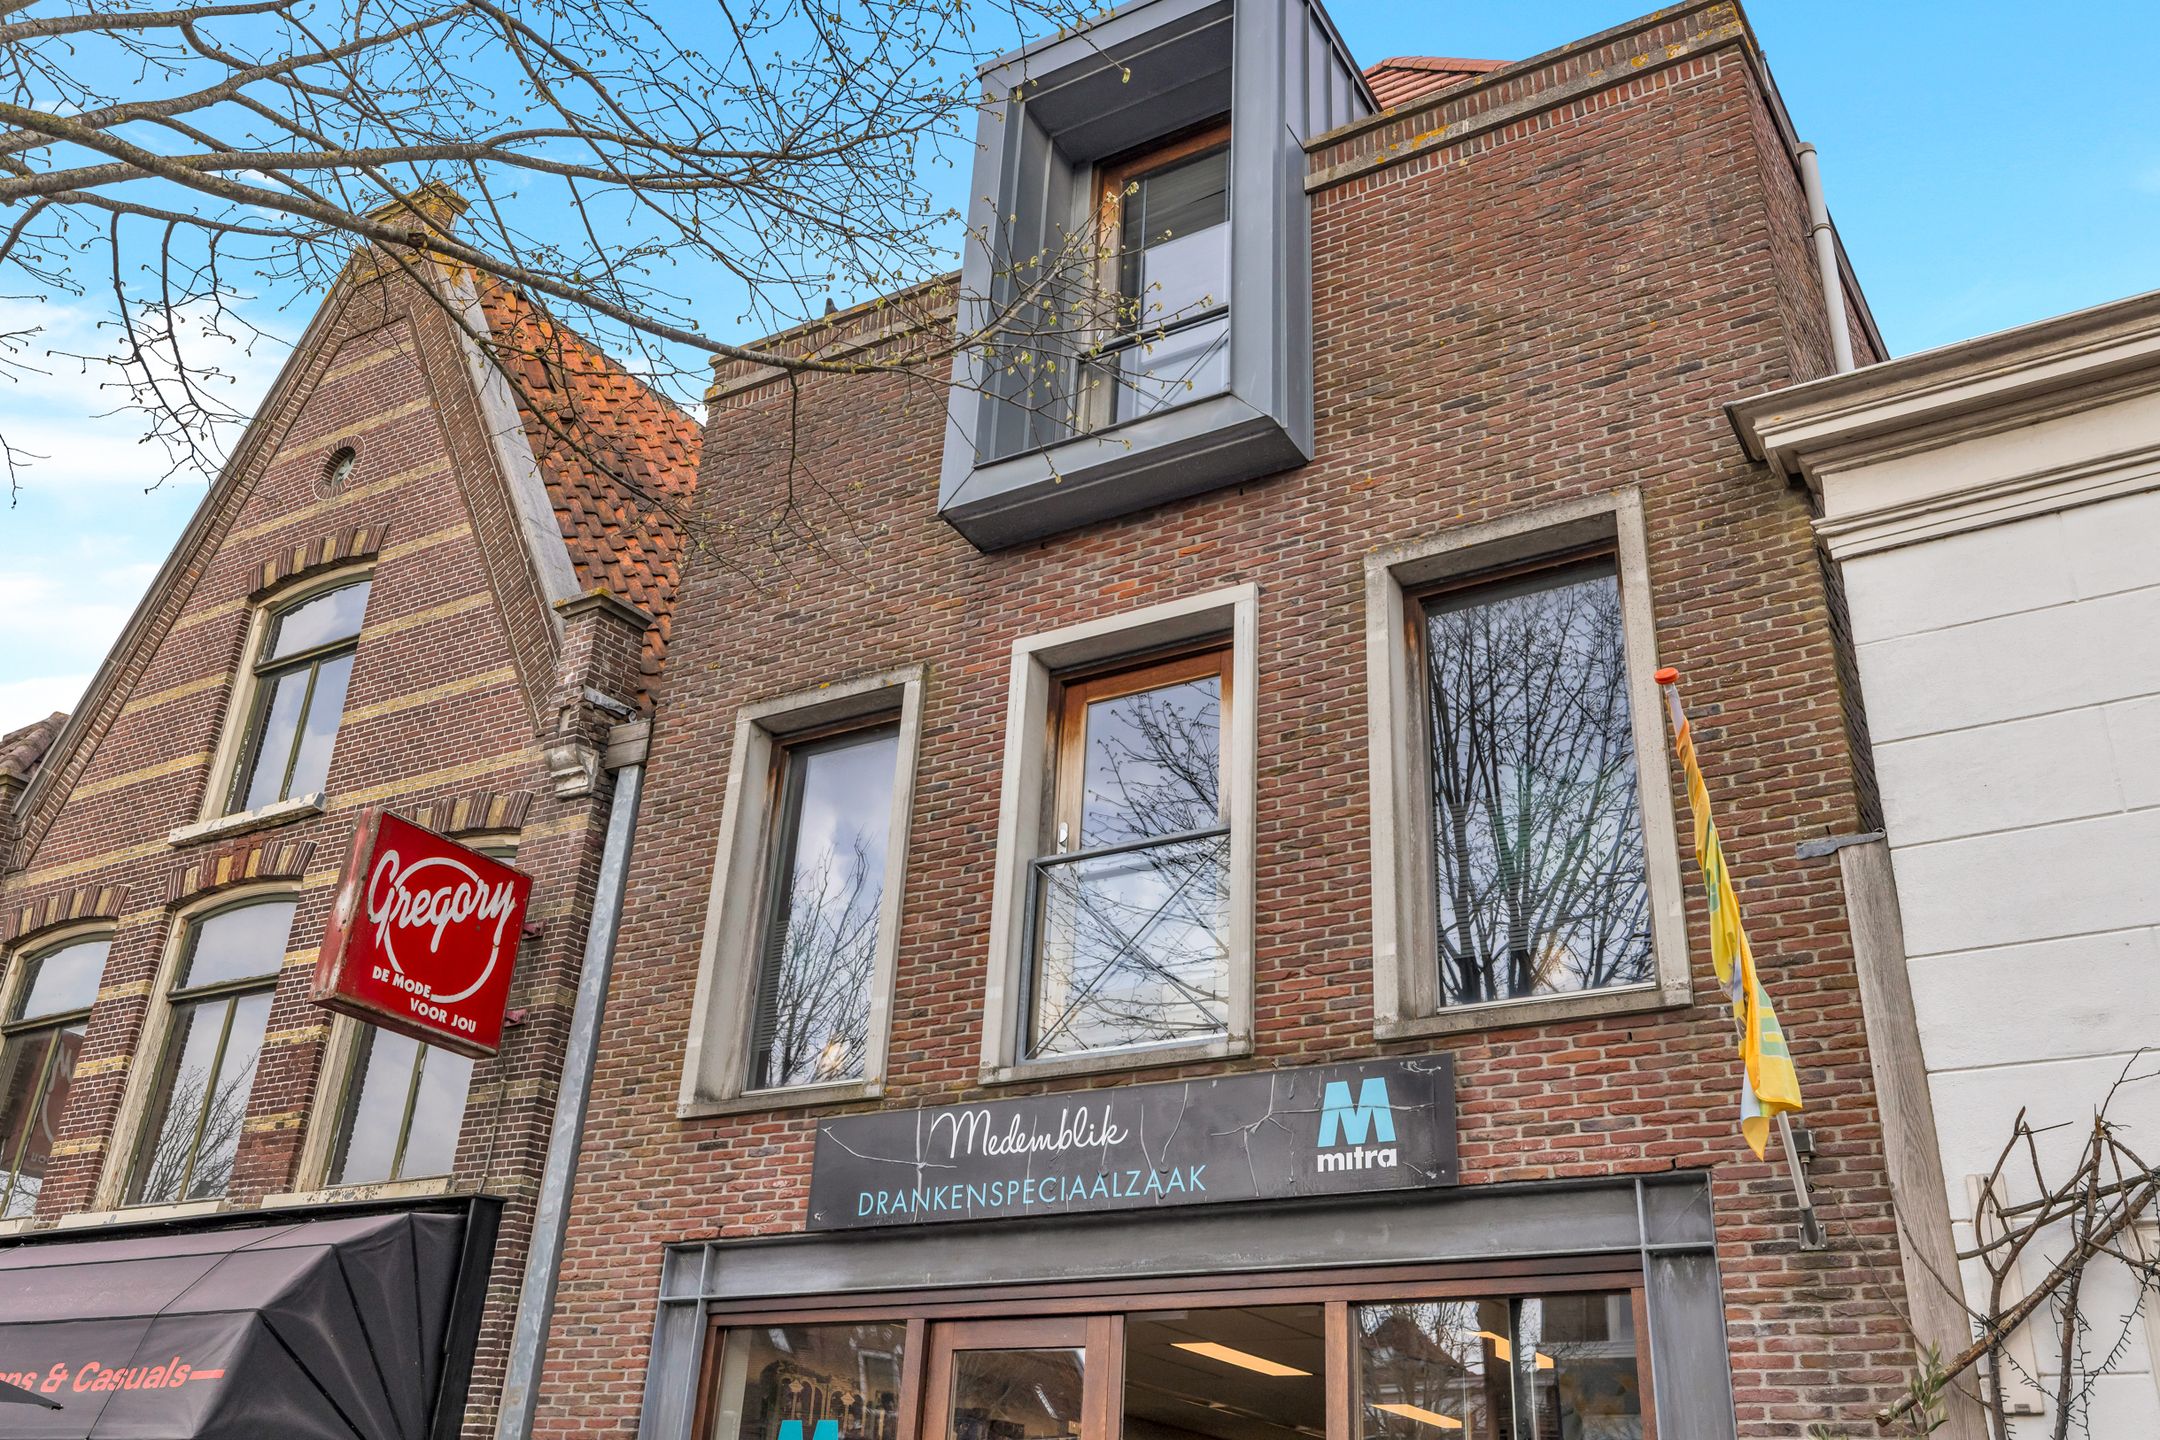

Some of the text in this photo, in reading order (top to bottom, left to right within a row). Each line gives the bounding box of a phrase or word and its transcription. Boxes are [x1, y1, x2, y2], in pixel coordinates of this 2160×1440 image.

[368, 849, 516, 954] Gregory
[372, 965, 432, 999] DE MODE
[410, 998, 477, 1033] VOOR JOU
[929, 1105, 1129, 1159] Medemblik
[1317, 1146, 1398, 1173] mitra
[858, 1164, 1207, 1217] DRANKENSPECIAALZAAK
[40, 1362, 69, 1392] &
[72, 1356, 192, 1393] Casuals
